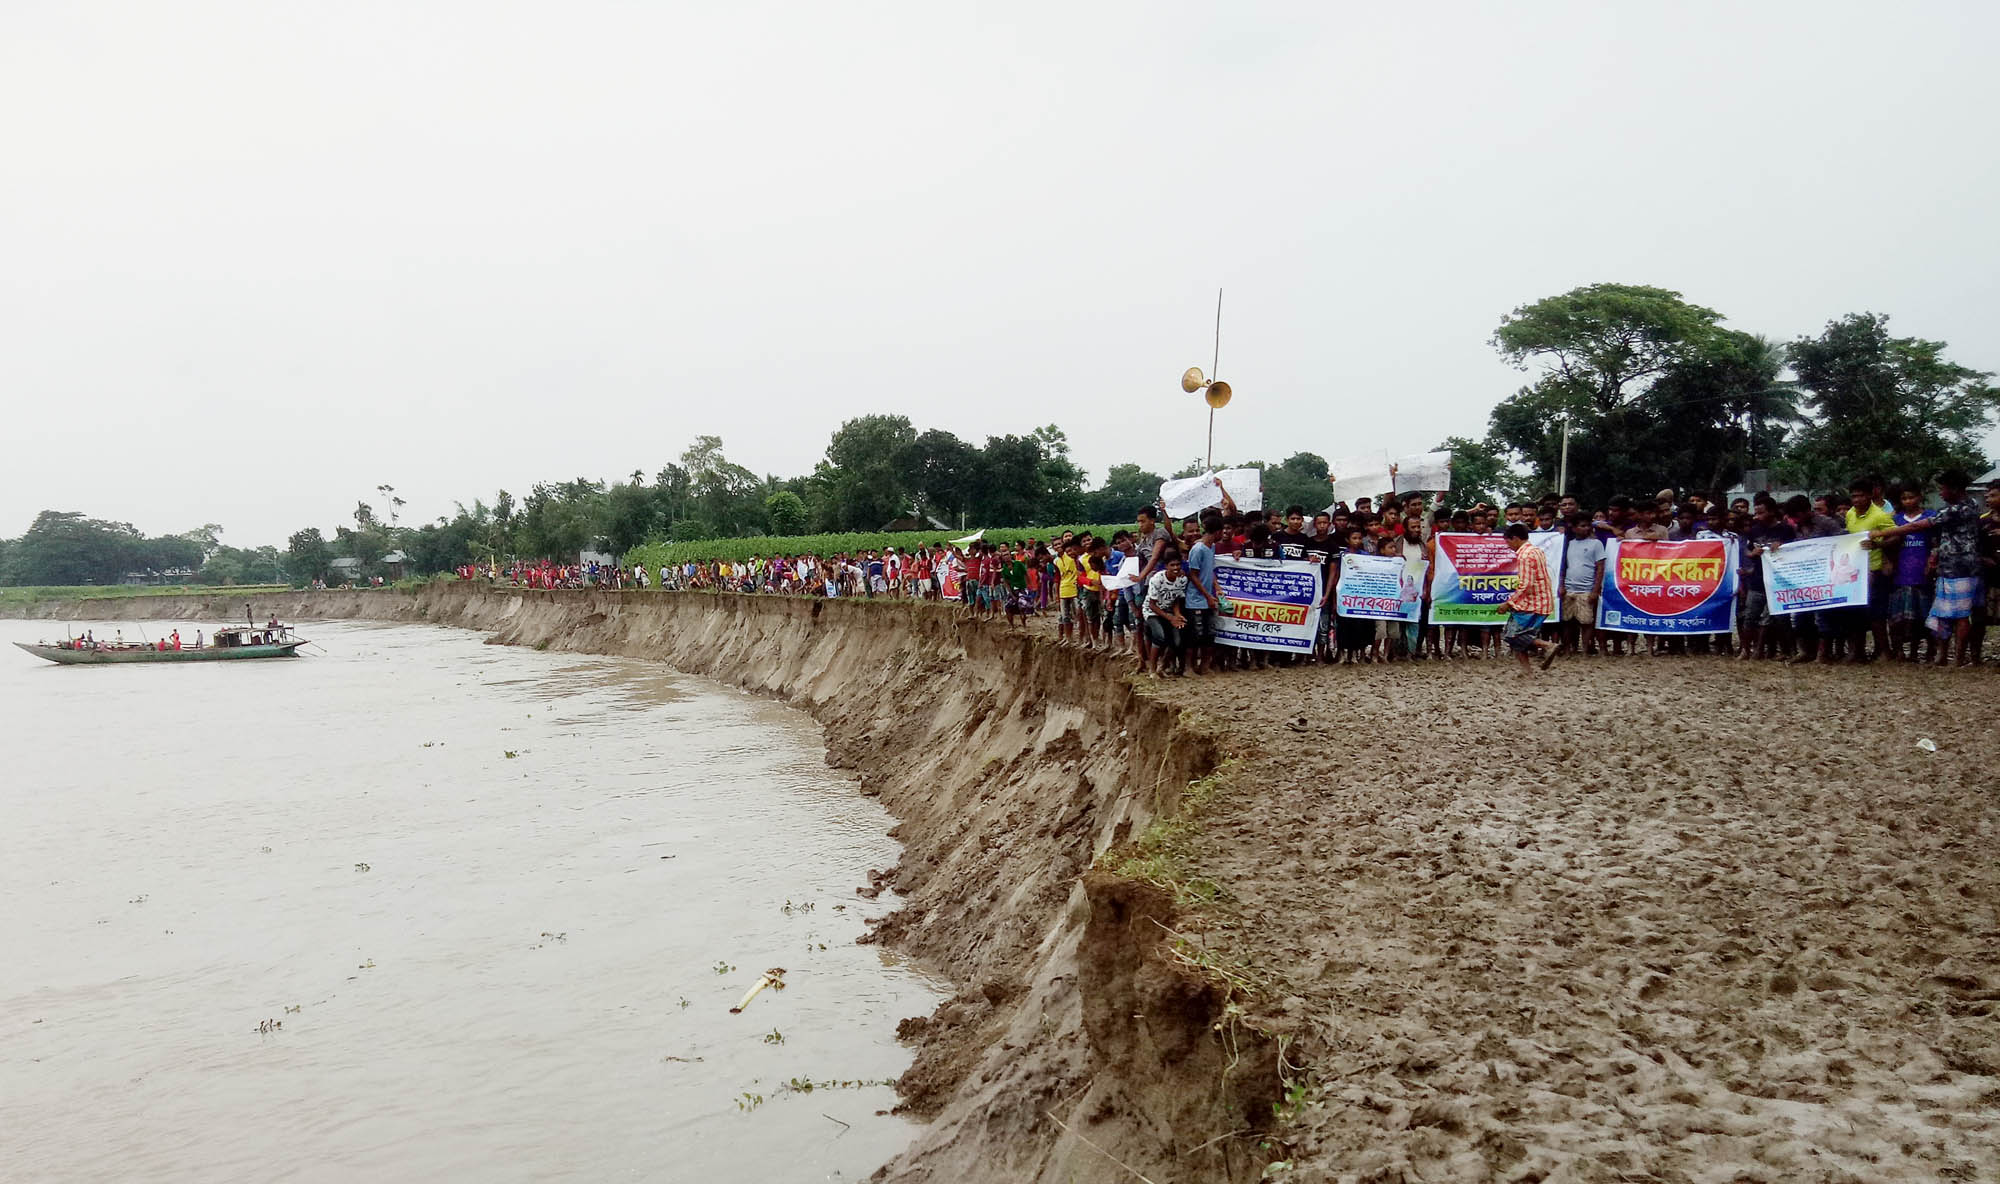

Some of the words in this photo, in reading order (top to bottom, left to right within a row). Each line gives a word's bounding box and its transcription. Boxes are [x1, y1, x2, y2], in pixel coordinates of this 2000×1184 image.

[1621, 558, 1721, 581] মানববন্ধন
[1472, 592, 1495, 601] সফল
[1628, 585, 1664, 597] সফল
[1666, 585, 1701, 597] হোক
[1341, 595, 1403, 612] মানববন্ধন
[1235, 620, 1260, 632] সফল
[1261, 623, 1282, 634] হোক
